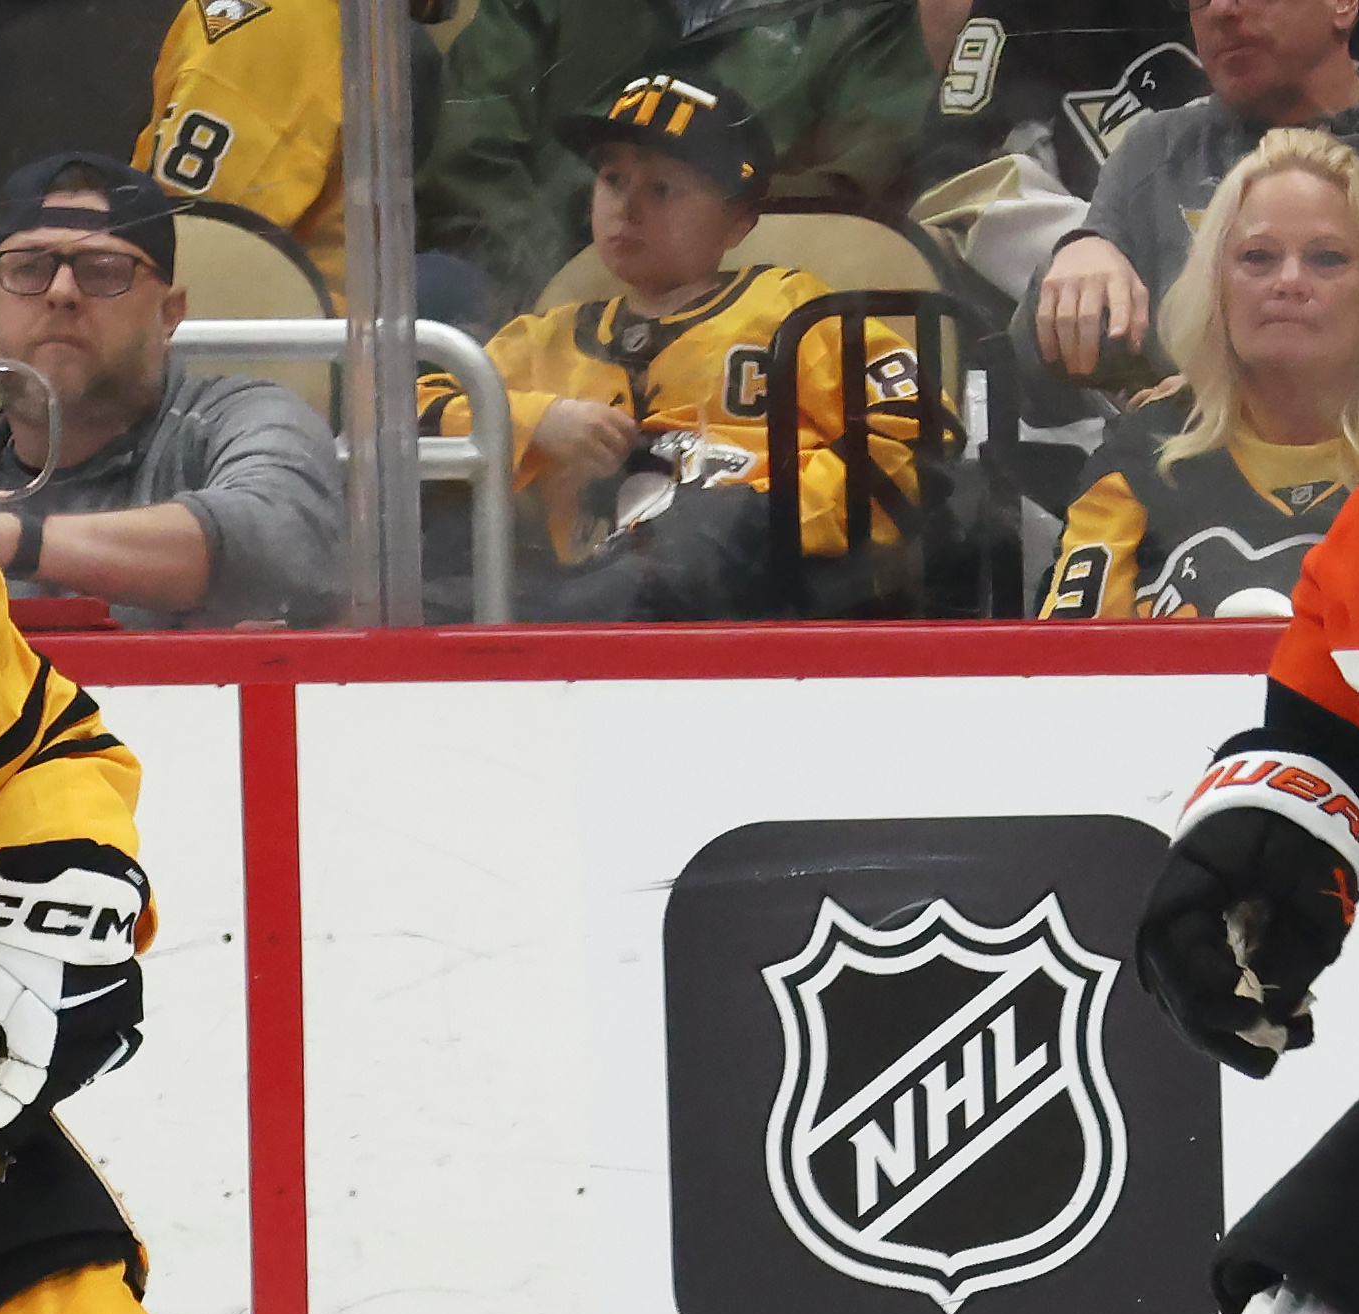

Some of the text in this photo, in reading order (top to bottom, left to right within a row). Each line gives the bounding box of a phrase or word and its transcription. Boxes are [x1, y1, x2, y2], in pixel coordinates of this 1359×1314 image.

[607, 74, 719, 137] PIT
[939, 17, 1007, 115] 9
[151, 102, 235, 194] 8
[847, 1003, 1048, 1218] NHL
